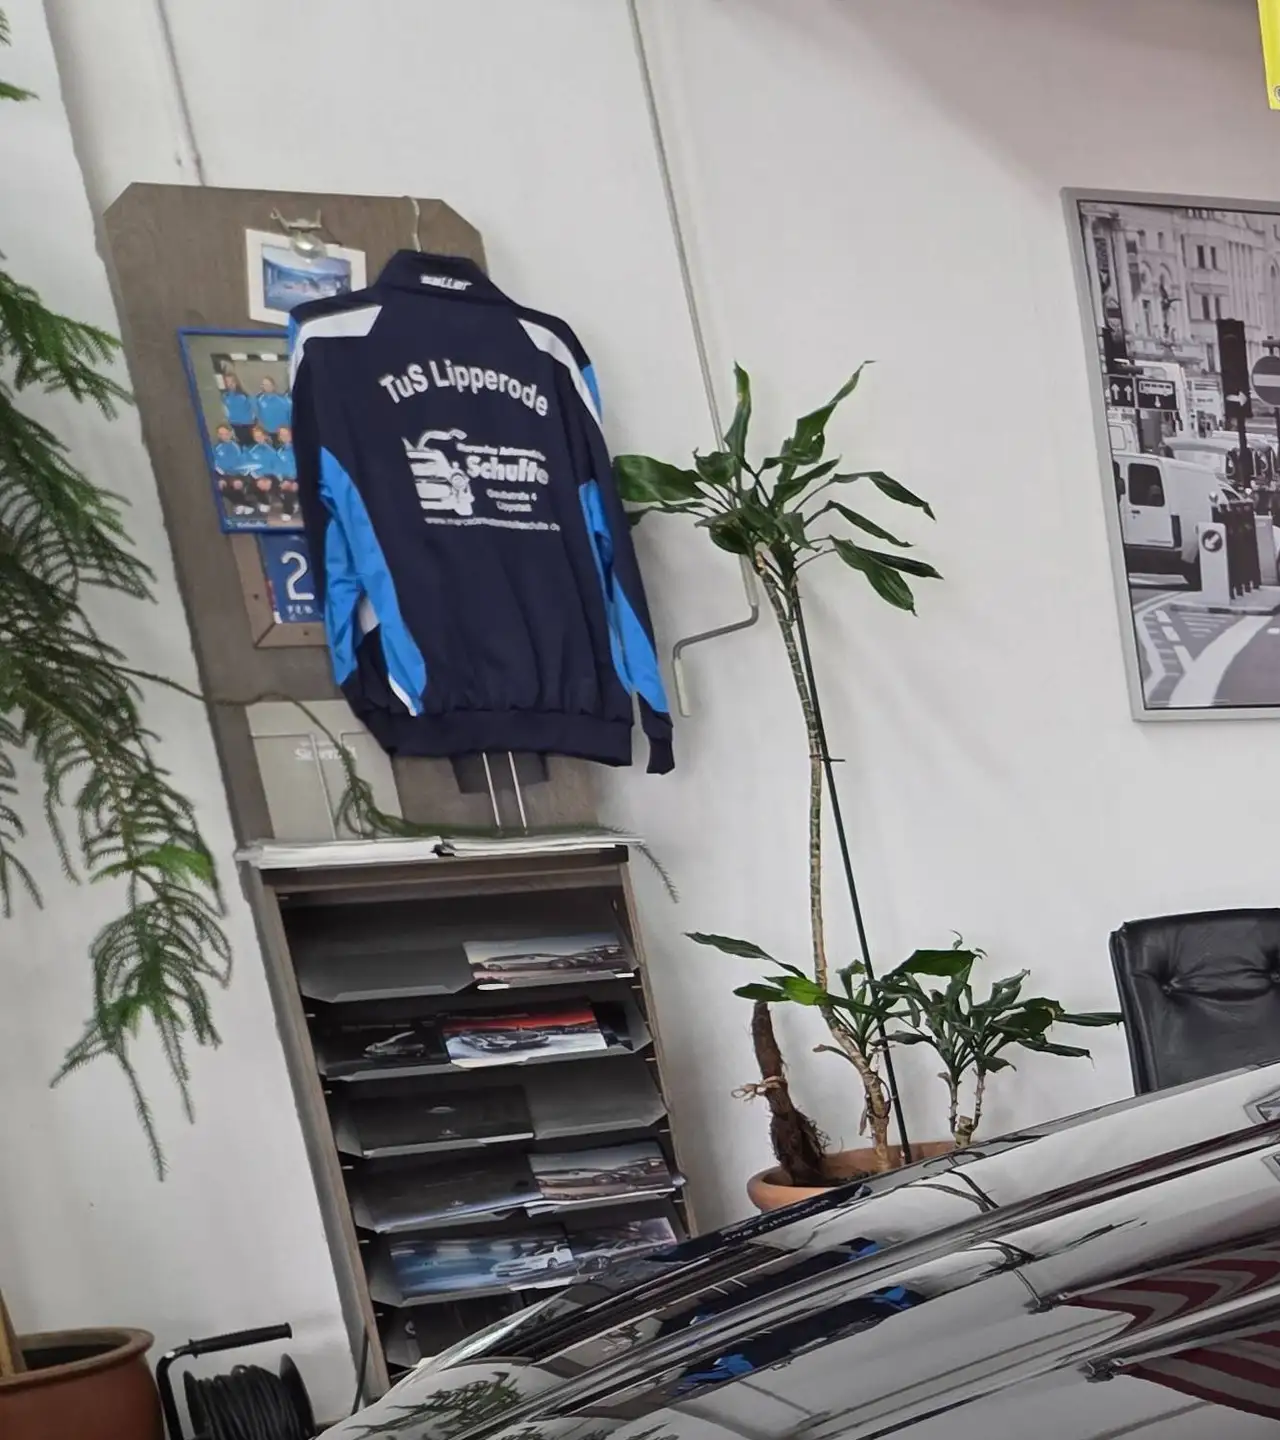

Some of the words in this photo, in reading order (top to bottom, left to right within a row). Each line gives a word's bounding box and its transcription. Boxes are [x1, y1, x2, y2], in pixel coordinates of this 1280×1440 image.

[379, 363, 429, 404] TuS
[429, 359, 548, 416] Lipperode
[466, 455, 549, 485] Schulte
